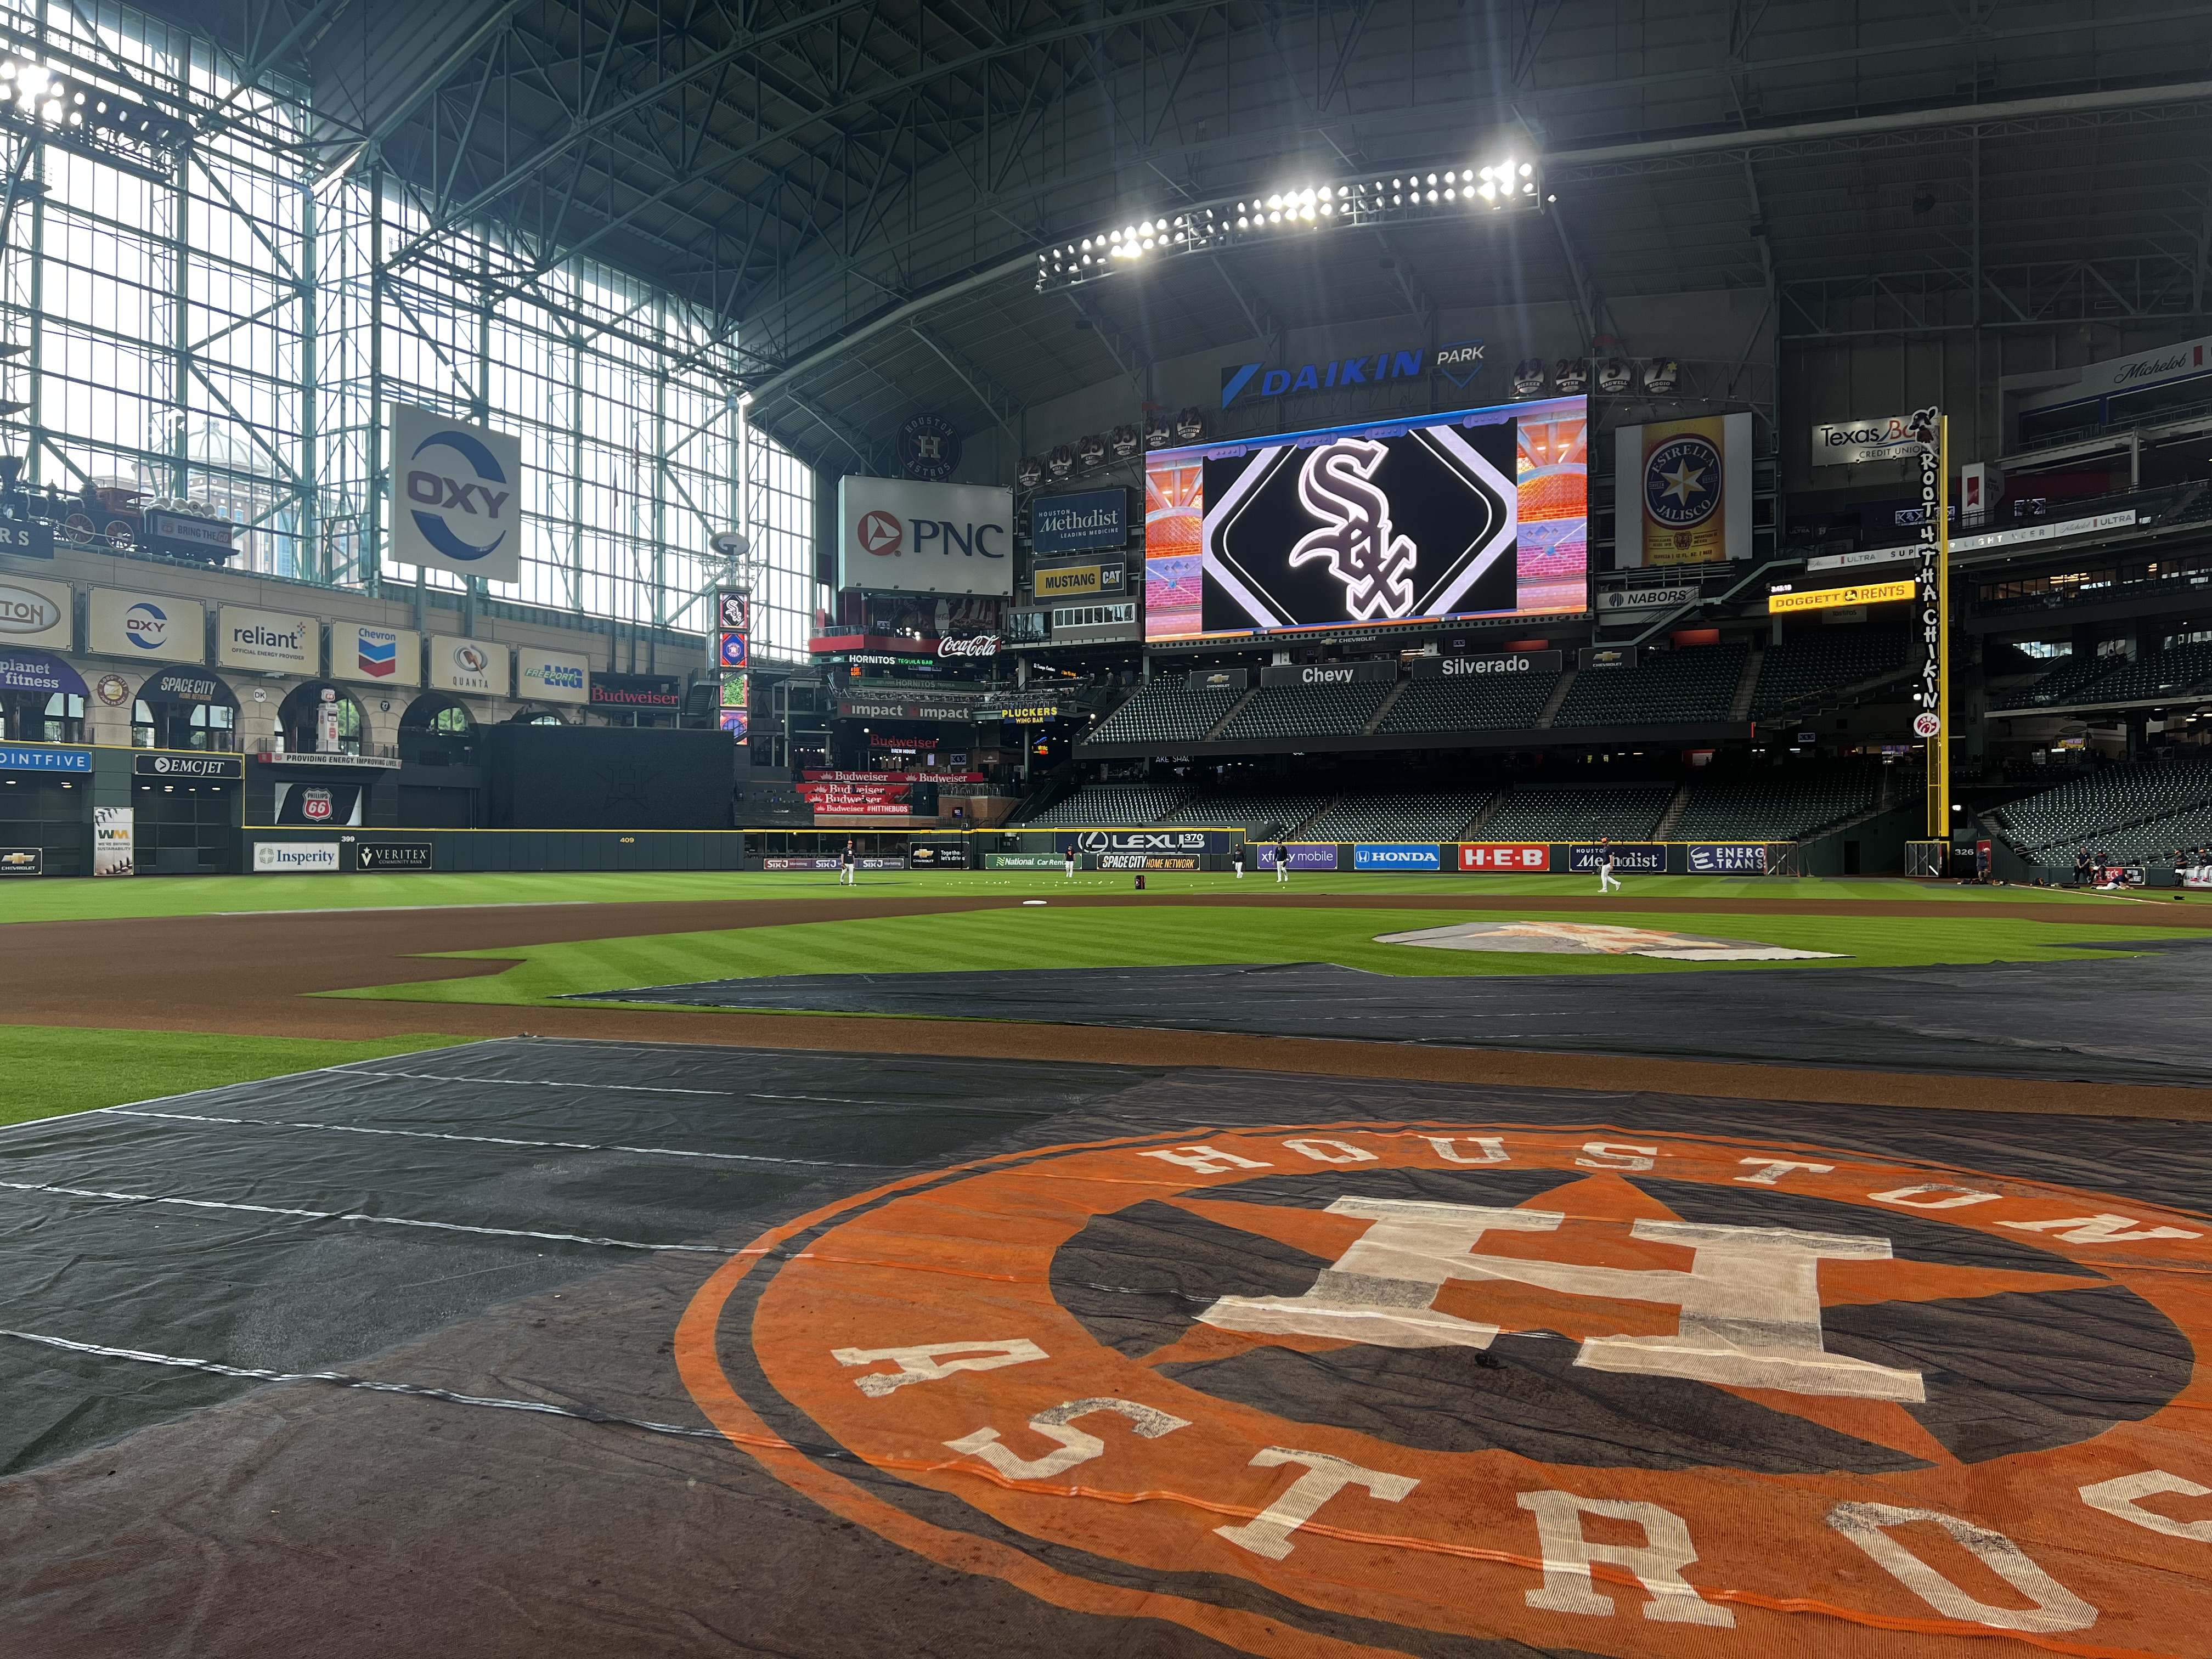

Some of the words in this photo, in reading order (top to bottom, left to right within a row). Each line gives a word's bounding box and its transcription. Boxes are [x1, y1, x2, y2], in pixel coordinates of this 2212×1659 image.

[1437, 345, 1486, 365] PARK
[1262, 348, 1425, 396] DAIKIN
[1514, 358, 1542, 380] 49
[1556, 357, 1585, 380] 24
[1607, 357, 1621, 379] 5
[1652, 357, 1667, 380] 7
[2114, 352, 2187, 383] Michelob
[1602, 380, 1628, 388] BAGWELL
[1145, 415, 1167, 435] 34
[1177, 407, 1199, 427] 42
[905, 417, 953, 436] HOUSTON
[1113, 424, 1134, 444] 33
[1821, 427, 1880, 447] Texas
[1889, 420, 1916, 439] Ba
[918, 435, 940, 459] H
[1080, 437, 1102, 454] 25
[1859, 449, 1891, 459] CREDIT
[1895, 444, 1927, 455] UNION
[1048, 445, 1069, 465] 40
[1652, 444, 1715, 473] ESTRELLA
[907, 460, 950, 476] ASTROS
[1018, 456, 1039, 476] 32
[407, 470, 510, 518] OXY
[1921, 454, 1937, 517] ROOT
[1039, 509, 1070, 517] HOUSTON
[1657, 499, 1711, 520] JALISCO
[1039, 509, 1118, 532] Methodist
[2100, 515, 2132, 526] ULTRA
[178, 525, 201, 538] BRING
[202, 529, 217, 540] THE
[909, 519, 1004, 558] PNC
[1060, 531, 1086, 539] LEADING
[1921, 526, 1934, 542] 4
[1847, 554, 1875, 563] ULTRA
[1046, 573, 1095, 589] MUSTANG
[1102, 571, 1121, 584] CAT
[1921, 551, 1937, 601] THA
[1628, 590, 1686, 605] NABORS
[1776, 593, 1840, 608] DOGGETT
[1861, 585, 1905, 600] RENTS
[127, 619, 165, 632] OXY
[234, 626, 298, 649] reliant
[359, 628, 396, 641] Chevron
[937, 634, 1000, 658] Coca-Cola
[0, 659, 50, 675] planet
[849, 654, 895, 664] HORNITOS
[1442, 655, 1530, 675] Silverado
[1923, 609, 1938, 708] CHIKIN
[5, 672, 59, 689] fitness
[453, 676, 488, 689] QUANTA
[526, 668, 575, 682] FREEPORT
[544, 664, 582, 689] LNG
[896, 679, 935, 687] HORNITOS
[1302, 667, 1353, 683] Chevy
[161, 676, 191, 693] SPACE
[191, 679, 217, 695] CITY
[592, 687, 679, 704] Budweiser
[852, 704, 902, 718] impact
[919, 708, 969, 720] impact
[1002, 707, 1058, 718] PLUCKERS
[870, 734, 939, 748] Budweiser
[170, 759, 225, 776] EMCJET
[286, 754, 326, 763] PROVIDING
[357, 758, 385, 766] IMPROVING
[835, 771, 888, 781] Budweiser
[919, 772, 968, 783] Budweiser
[308, 801, 326, 814] 66
[98, 830, 129, 839] WM
[277, 850, 334, 865] Insperity
[376, 850, 426, 860] VERITEX
[1298, 850, 1333, 861] mobile
[1372, 852, 1438, 862] HONDA
[1464, 849, 1543, 866] H-E-B
[1576, 852, 1658, 867] Mehodist
[1717, 847, 1764, 858] ENERG
[1005, 857, 1034, 866] National
[1102, 855, 1128, 868] SPACE
[1128, 855, 1147, 868] CITY
[1146, 859, 1164, 868] HOME
[1165, 859, 1195, 868] NETWORK
[1717, 859, 1763, 869] TRANS
[1138, 1133, 2203, 1248] HOUSTON
[1194, 1196, 1927, 1404] H
